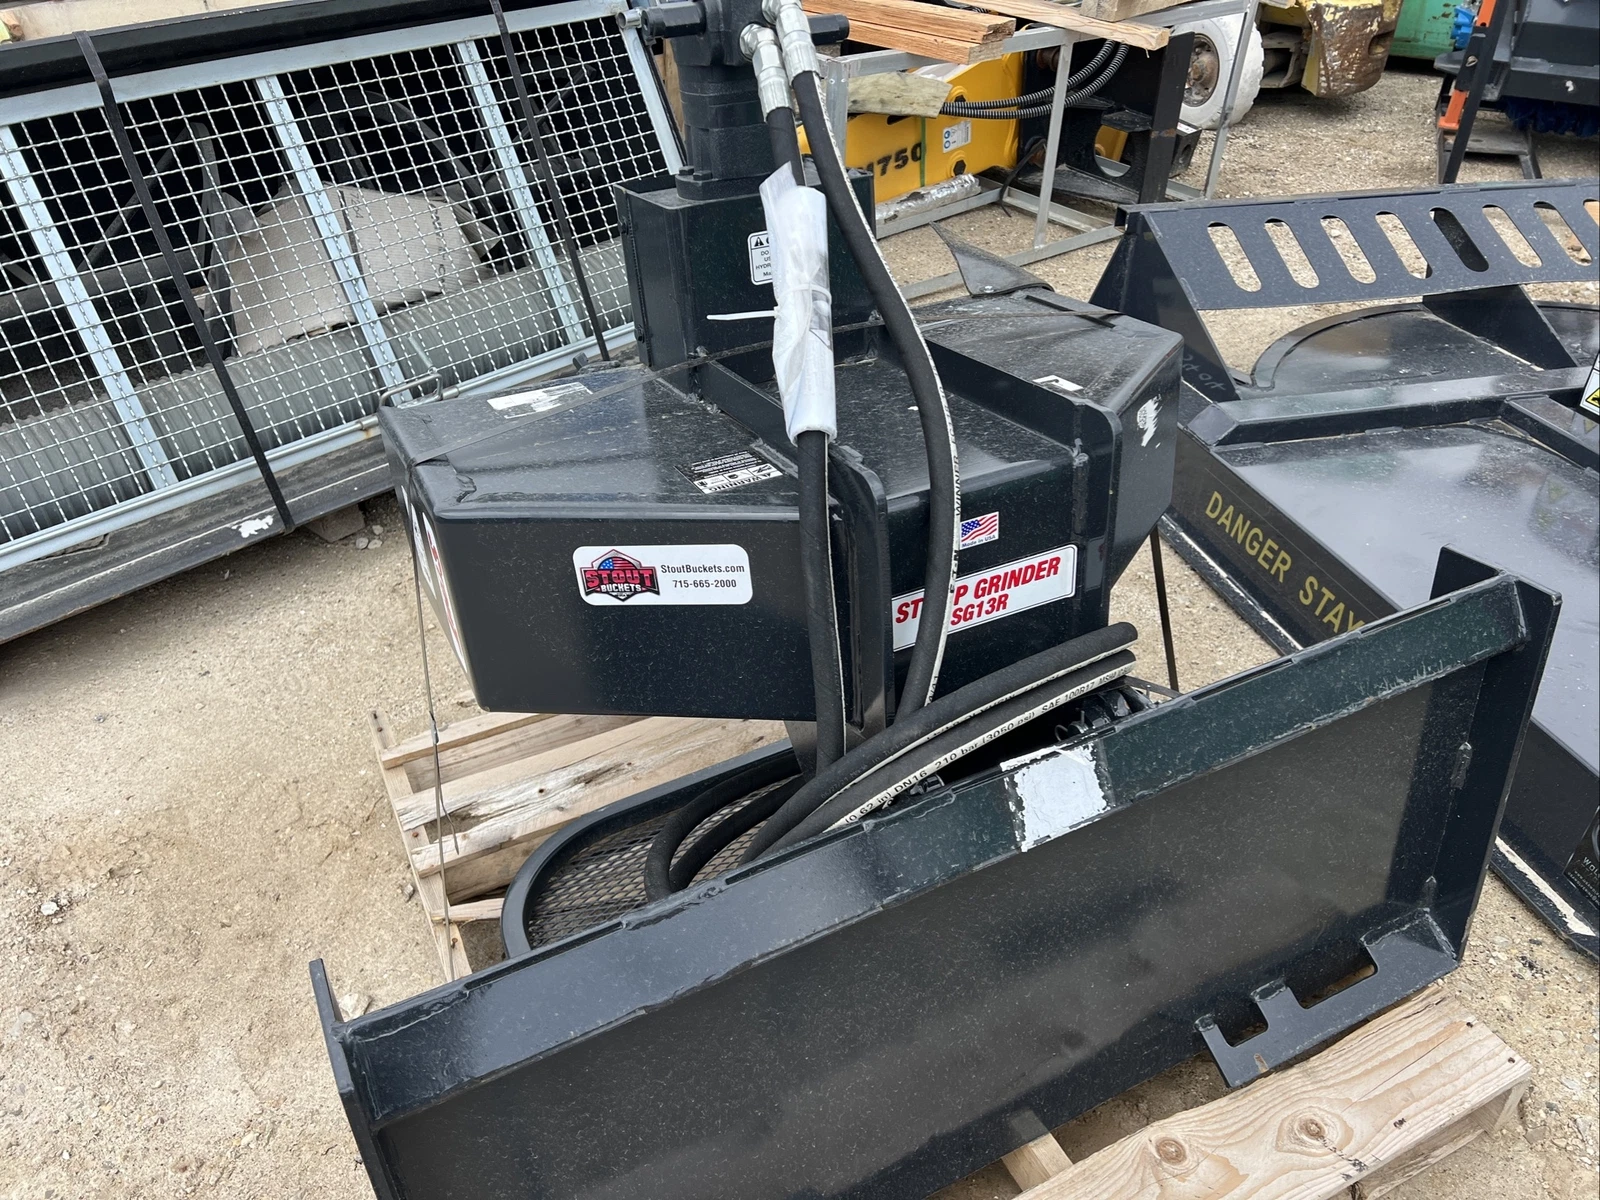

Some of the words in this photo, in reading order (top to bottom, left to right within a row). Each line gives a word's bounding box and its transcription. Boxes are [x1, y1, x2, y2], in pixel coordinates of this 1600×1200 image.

[660, 564, 745, 573] StoutBuckets.com
[1205, 490, 1292, 583] DANGER
[1298, 575, 1365, 634] STAY
[585, 569, 653, 588] STOUT
[600, 583, 642, 592] BUCKETS
[672, 579, 737, 588] 715-665-2000
[974, 556, 1062, 600] GRINDER
[950, 593, 1010, 626] SG13R
[894, 769, 928, 793] DN16
[935, 753, 958, 770] 210
[961, 742, 979, 755] bar
